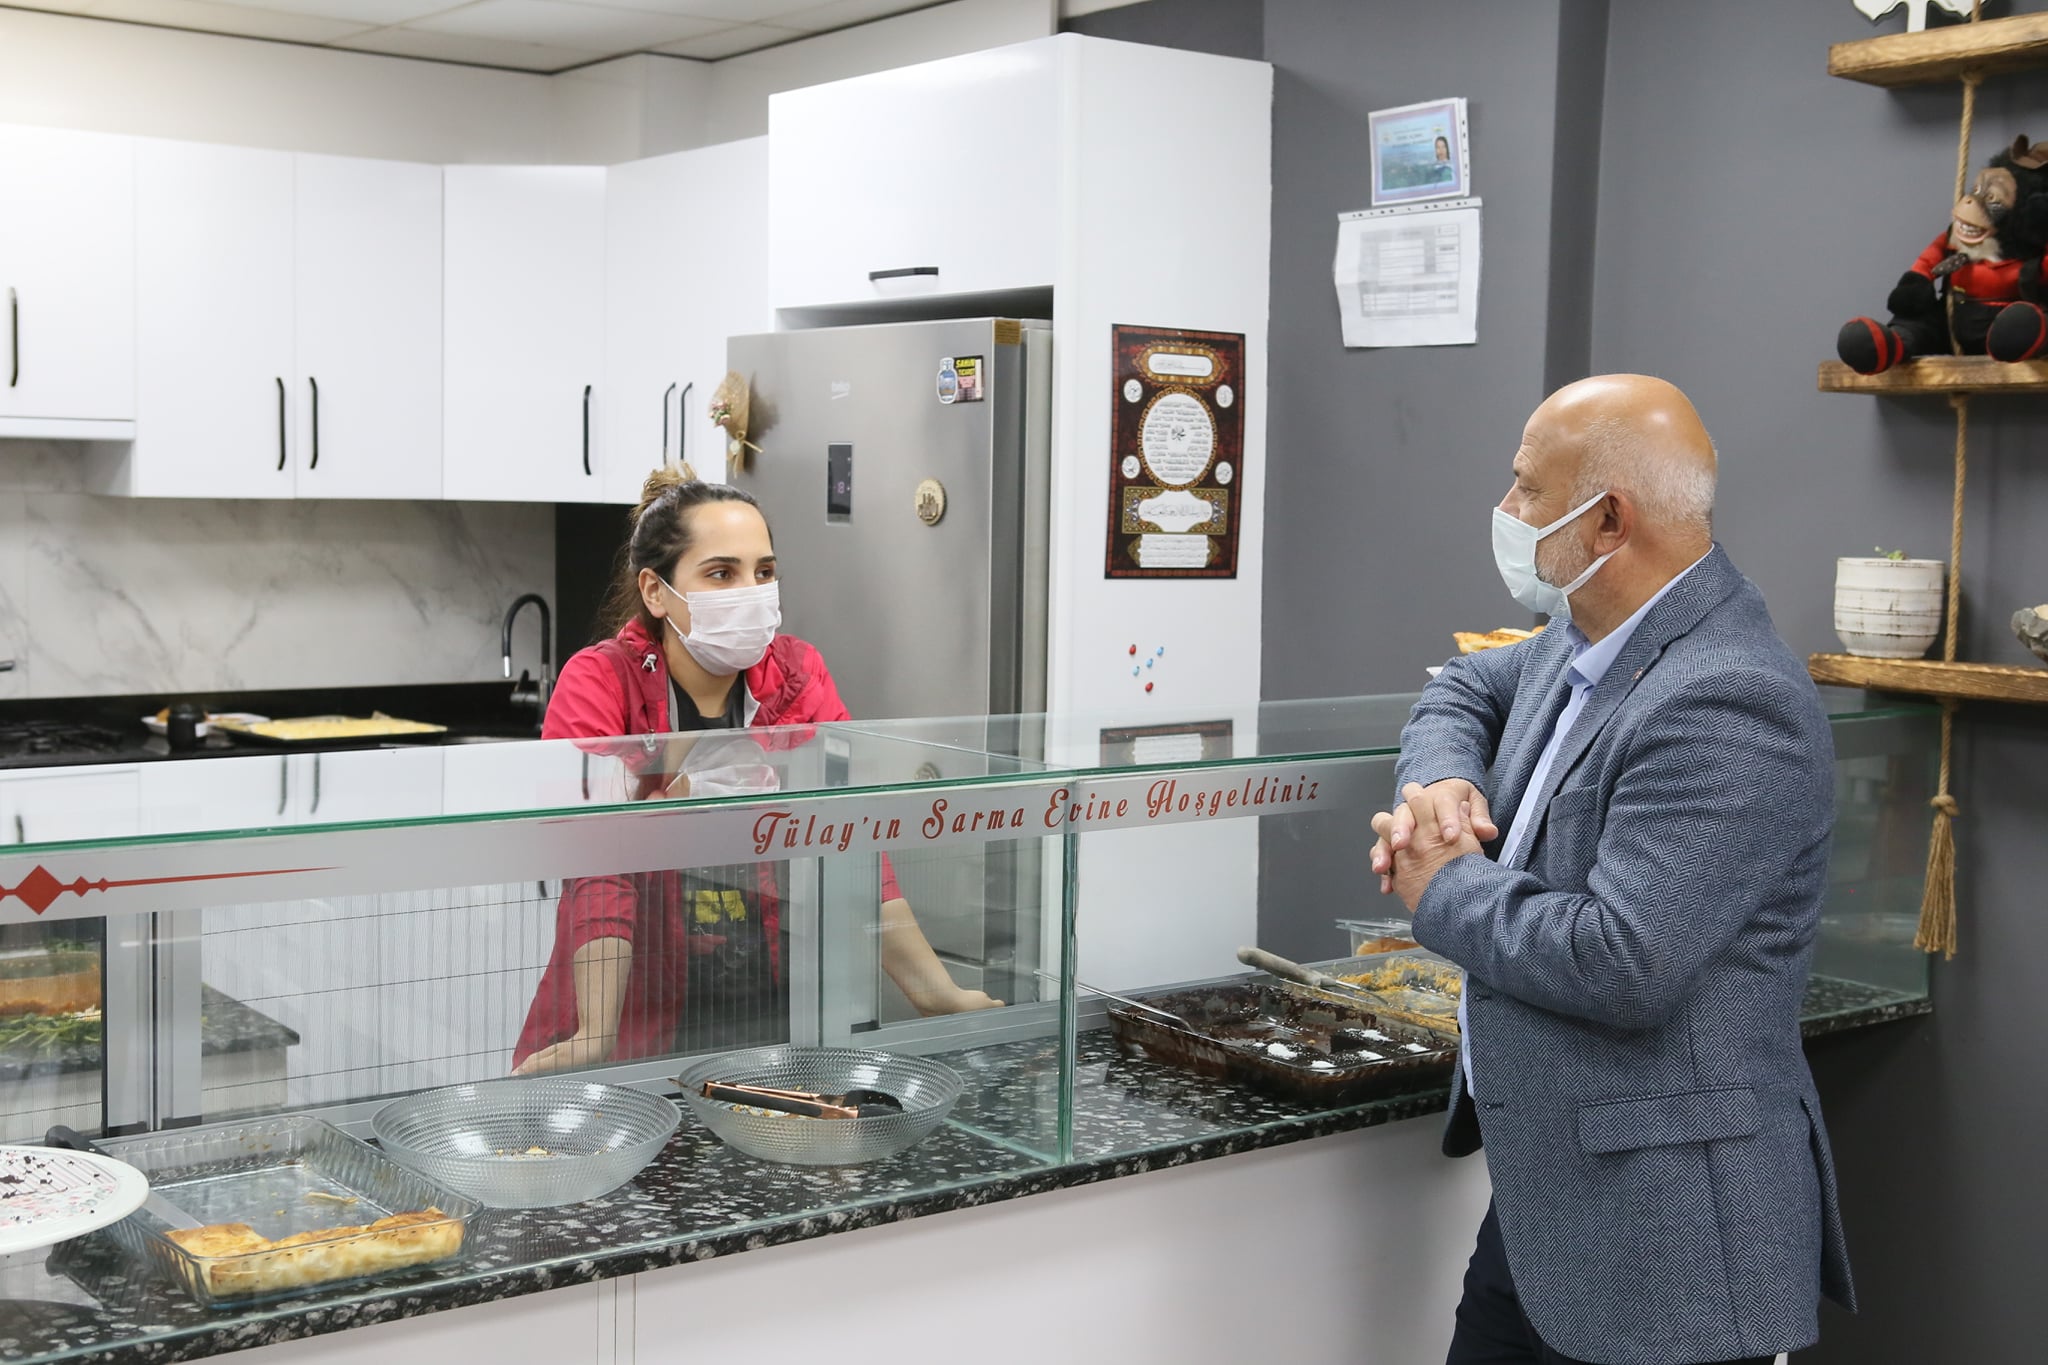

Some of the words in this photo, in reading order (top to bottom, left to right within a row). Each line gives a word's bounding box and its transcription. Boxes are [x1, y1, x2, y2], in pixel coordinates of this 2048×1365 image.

[752, 810, 901, 854] Tülay'ın
[922, 798, 1025, 840] Sarma
[1043, 788, 1128, 828] Evine
[1146, 775, 1319, 818] Hoşgeldiniz
